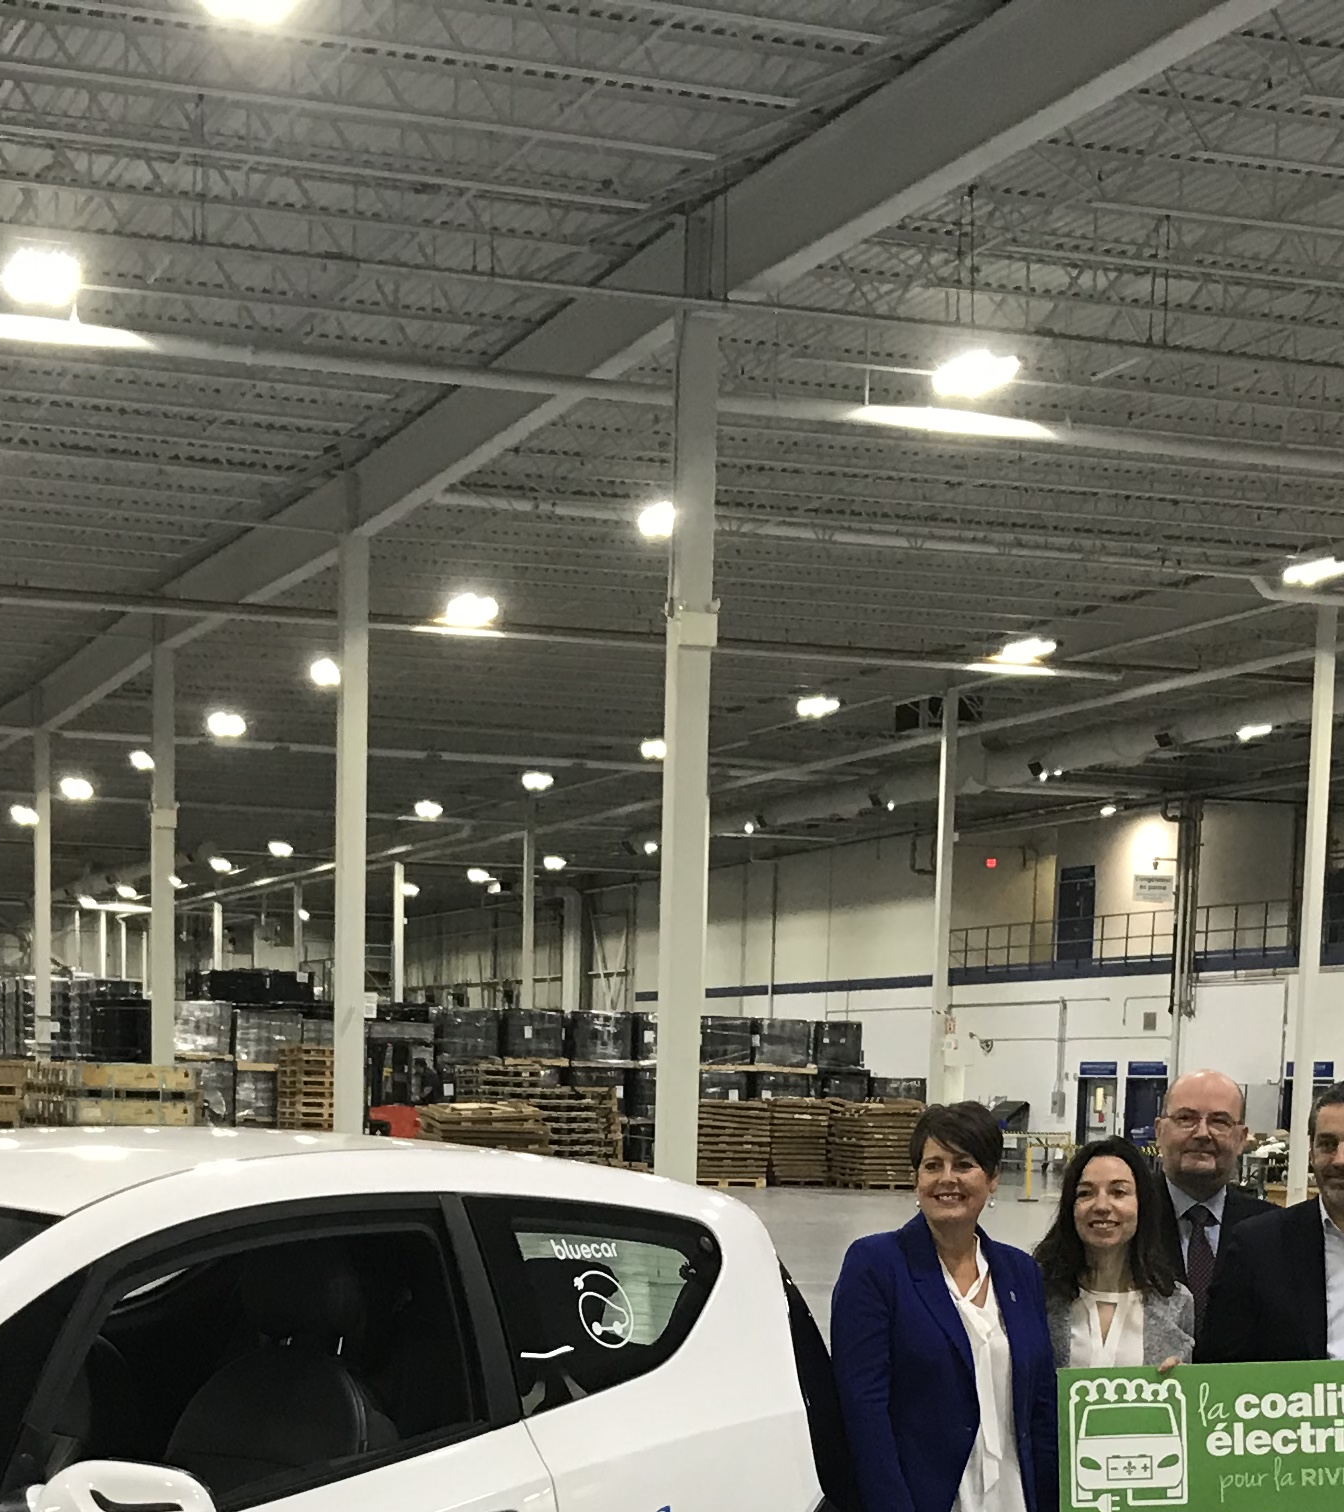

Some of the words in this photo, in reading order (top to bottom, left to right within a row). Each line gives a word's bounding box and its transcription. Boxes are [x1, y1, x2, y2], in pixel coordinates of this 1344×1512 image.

[549, 1238, 618, 1261] bluecar
[1198, 1382, 1230, 1427] la
[1219, 1471, 1268, 1503] pour
[1273, 1455, 1296, 1492] la
